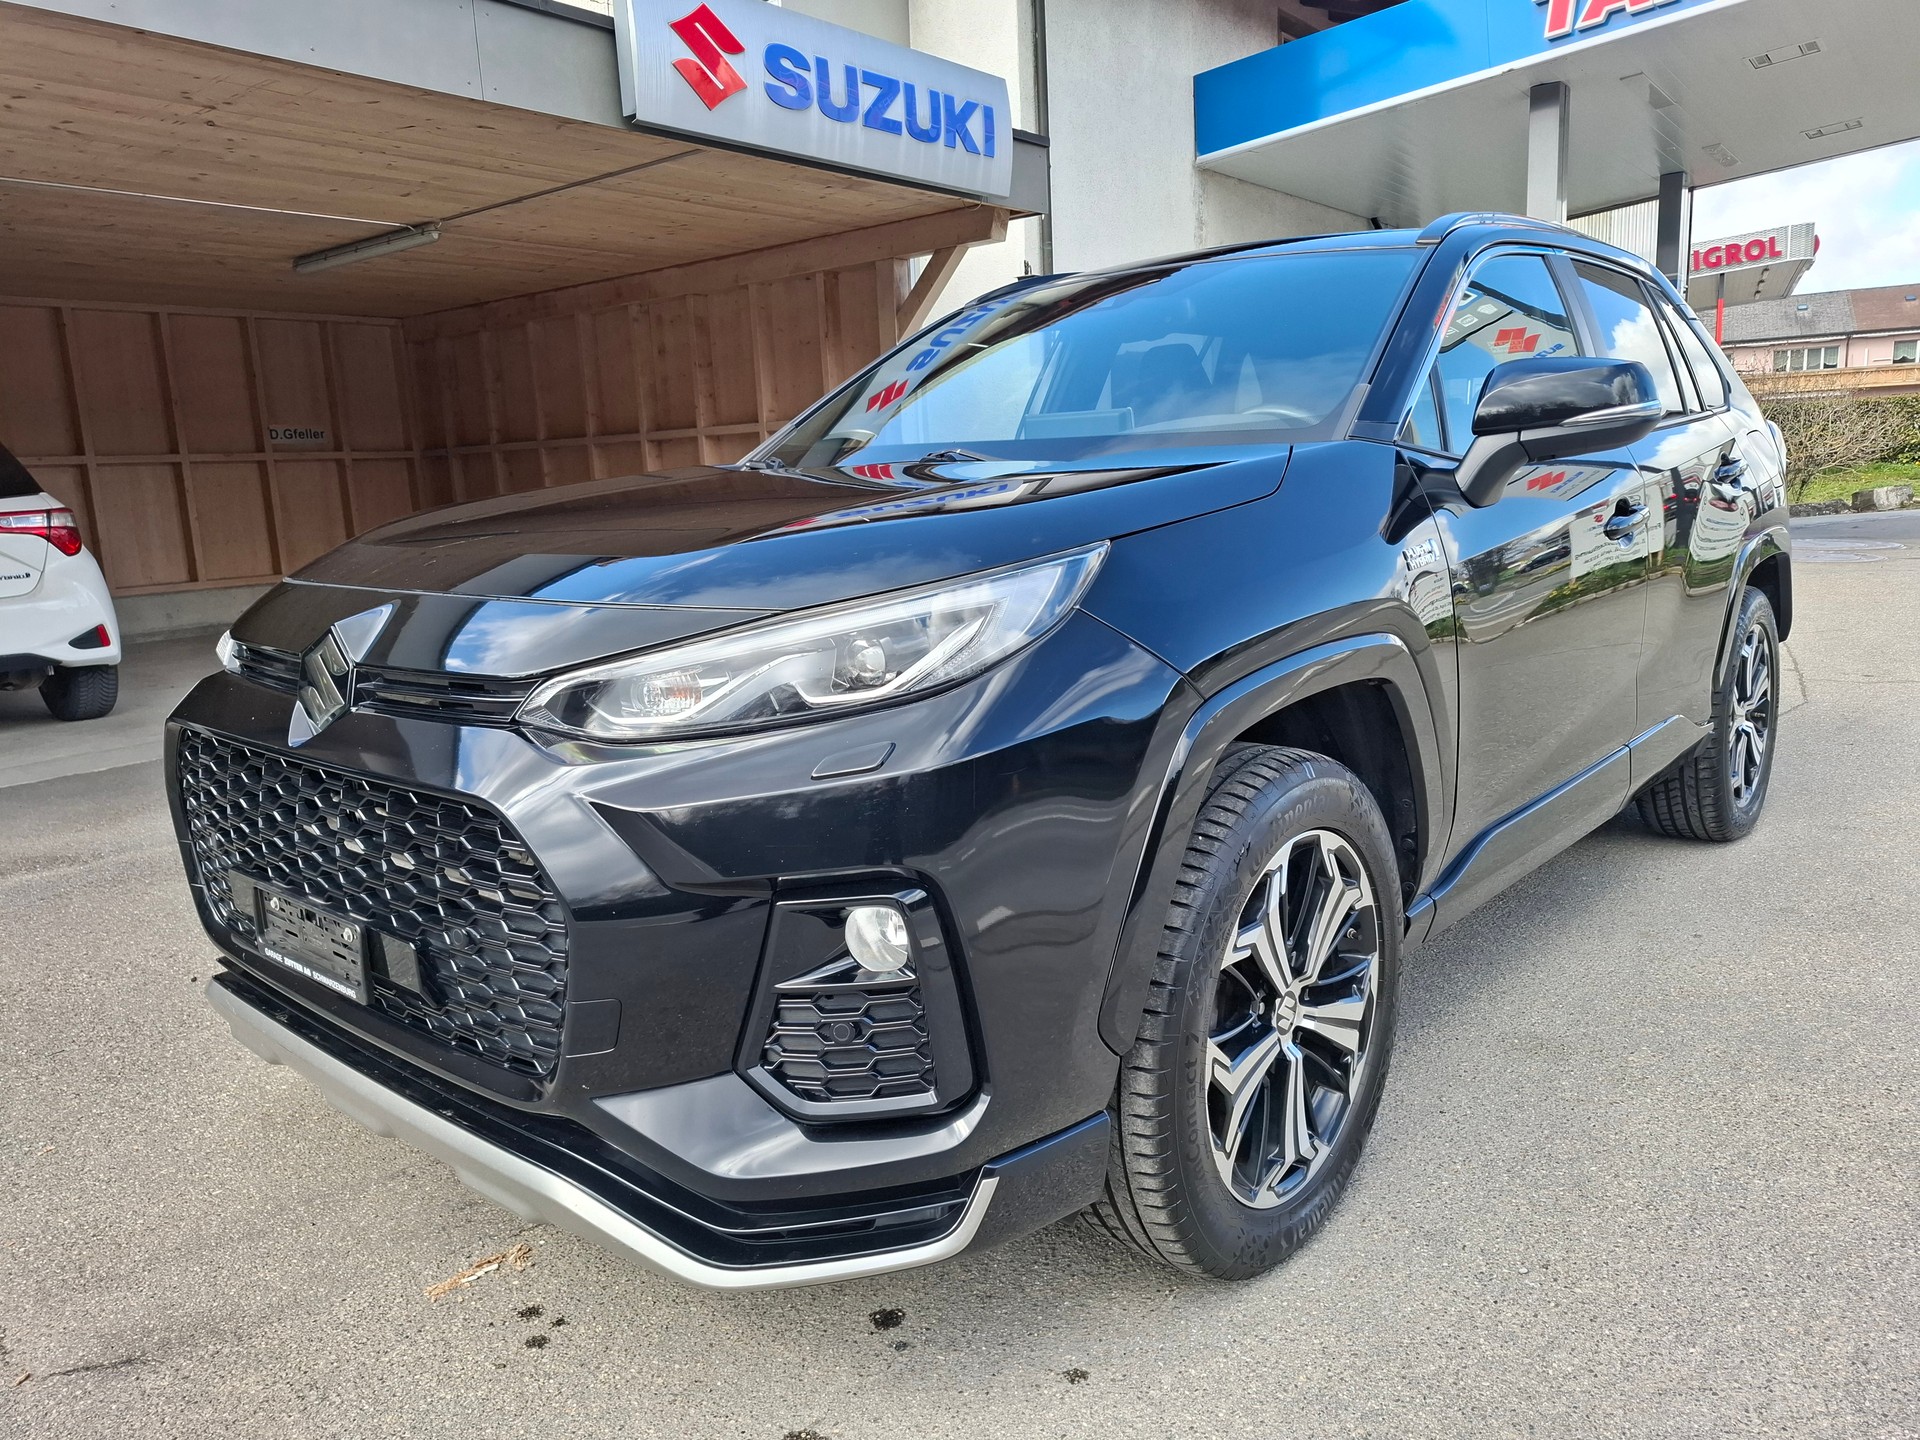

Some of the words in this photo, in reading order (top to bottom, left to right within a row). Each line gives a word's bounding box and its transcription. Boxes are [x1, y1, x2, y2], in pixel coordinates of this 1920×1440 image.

[762, 42, 996, 159] SUZUKI
[1692, 236, 1783, 272] IGROL
[269, 428, 325, 440] D.Gfeller
